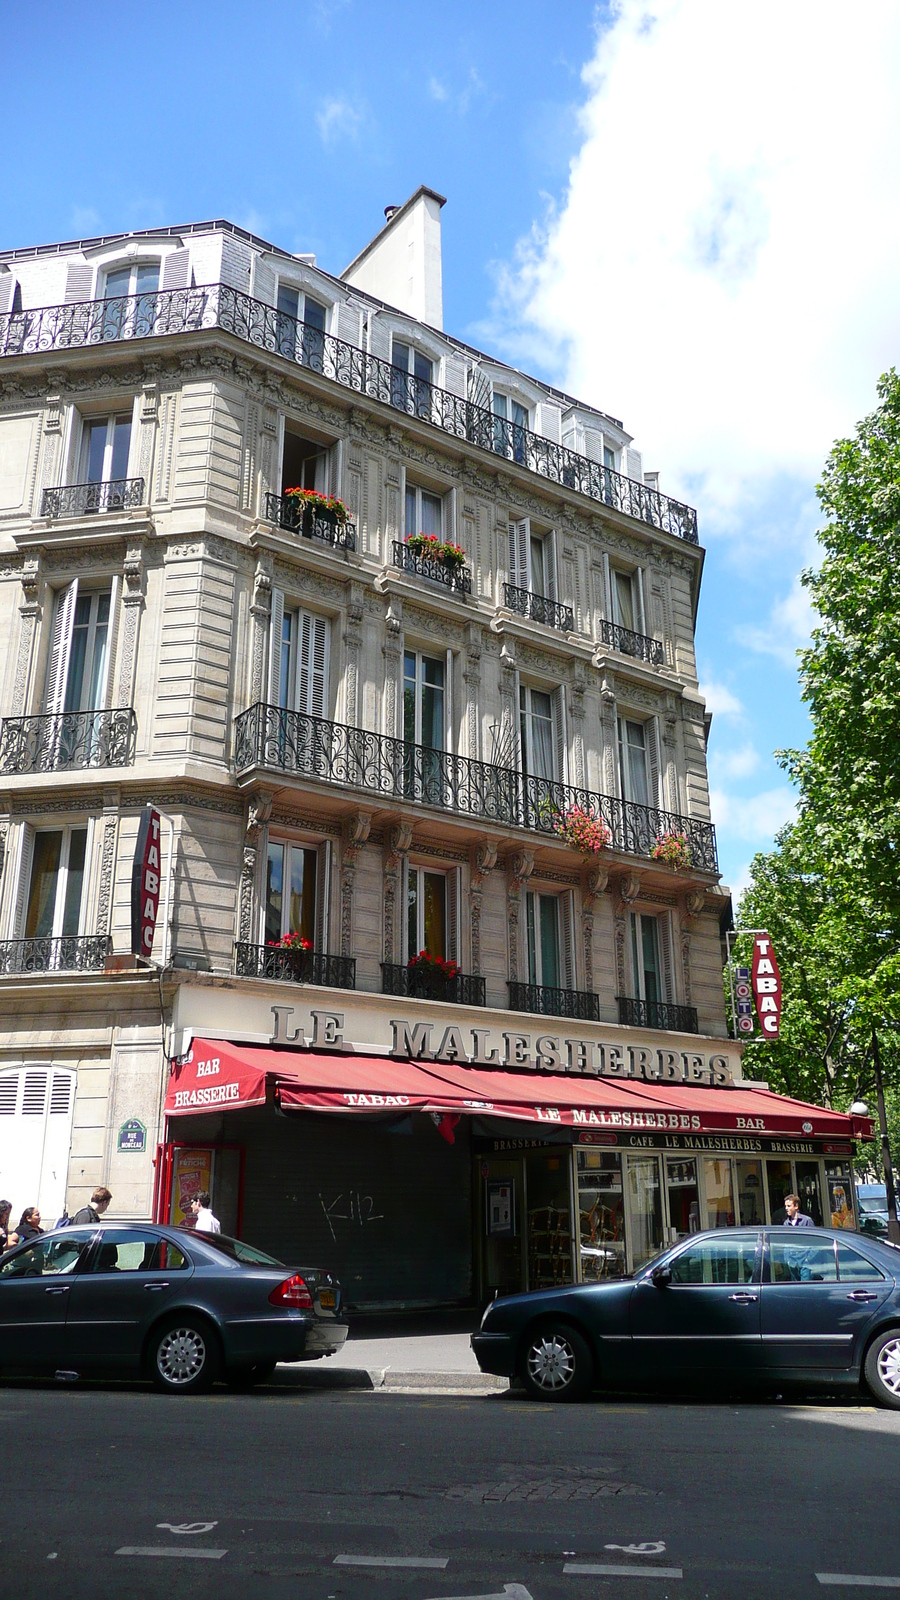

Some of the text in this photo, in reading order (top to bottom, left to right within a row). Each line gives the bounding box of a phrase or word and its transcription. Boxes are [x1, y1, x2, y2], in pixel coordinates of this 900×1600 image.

[144, 818, 160, 948] TABAC
[756, 939, 778, 1032] TABAC
[737, 969, 752, 1031] LOTO
[269, 1005, 732, 1086] LE MALESHERBES
[196, 1058, 220, 1078] BAR
[174, 1083, 239, 1107] BRASSERIE
[343, 1093, 410, 1106] TABAC
[534, 1106, 765, 1130] LE MALESHERBES BAR
[665, 1135, 680, 1147] LE
[684, 1135, 762, 1151] MALESHERBES
[771, 1142, 814, 1153] BRASSERIE
